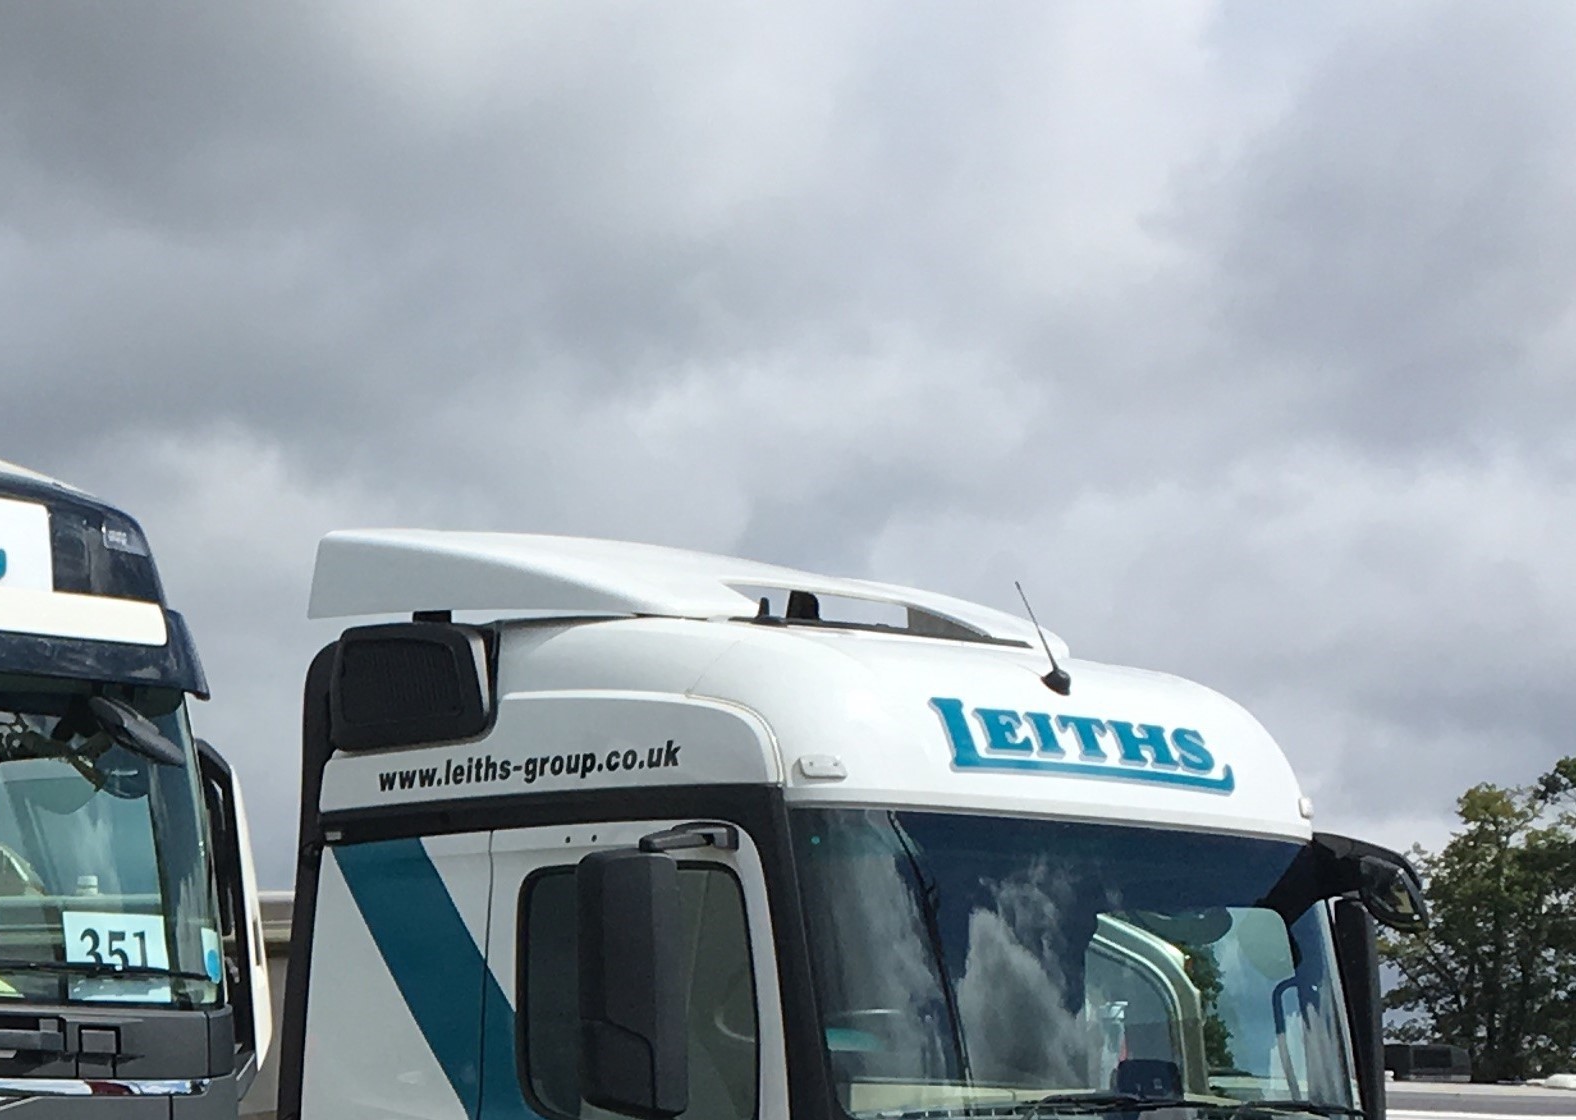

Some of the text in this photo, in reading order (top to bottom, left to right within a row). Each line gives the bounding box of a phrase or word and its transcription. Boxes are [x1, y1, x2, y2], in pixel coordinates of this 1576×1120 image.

[378, 740, 681, 792] www.leiths-group.co.uk
[927, 696, 1235, 797] LEITHS
[80, 928, 149, 974] 351
